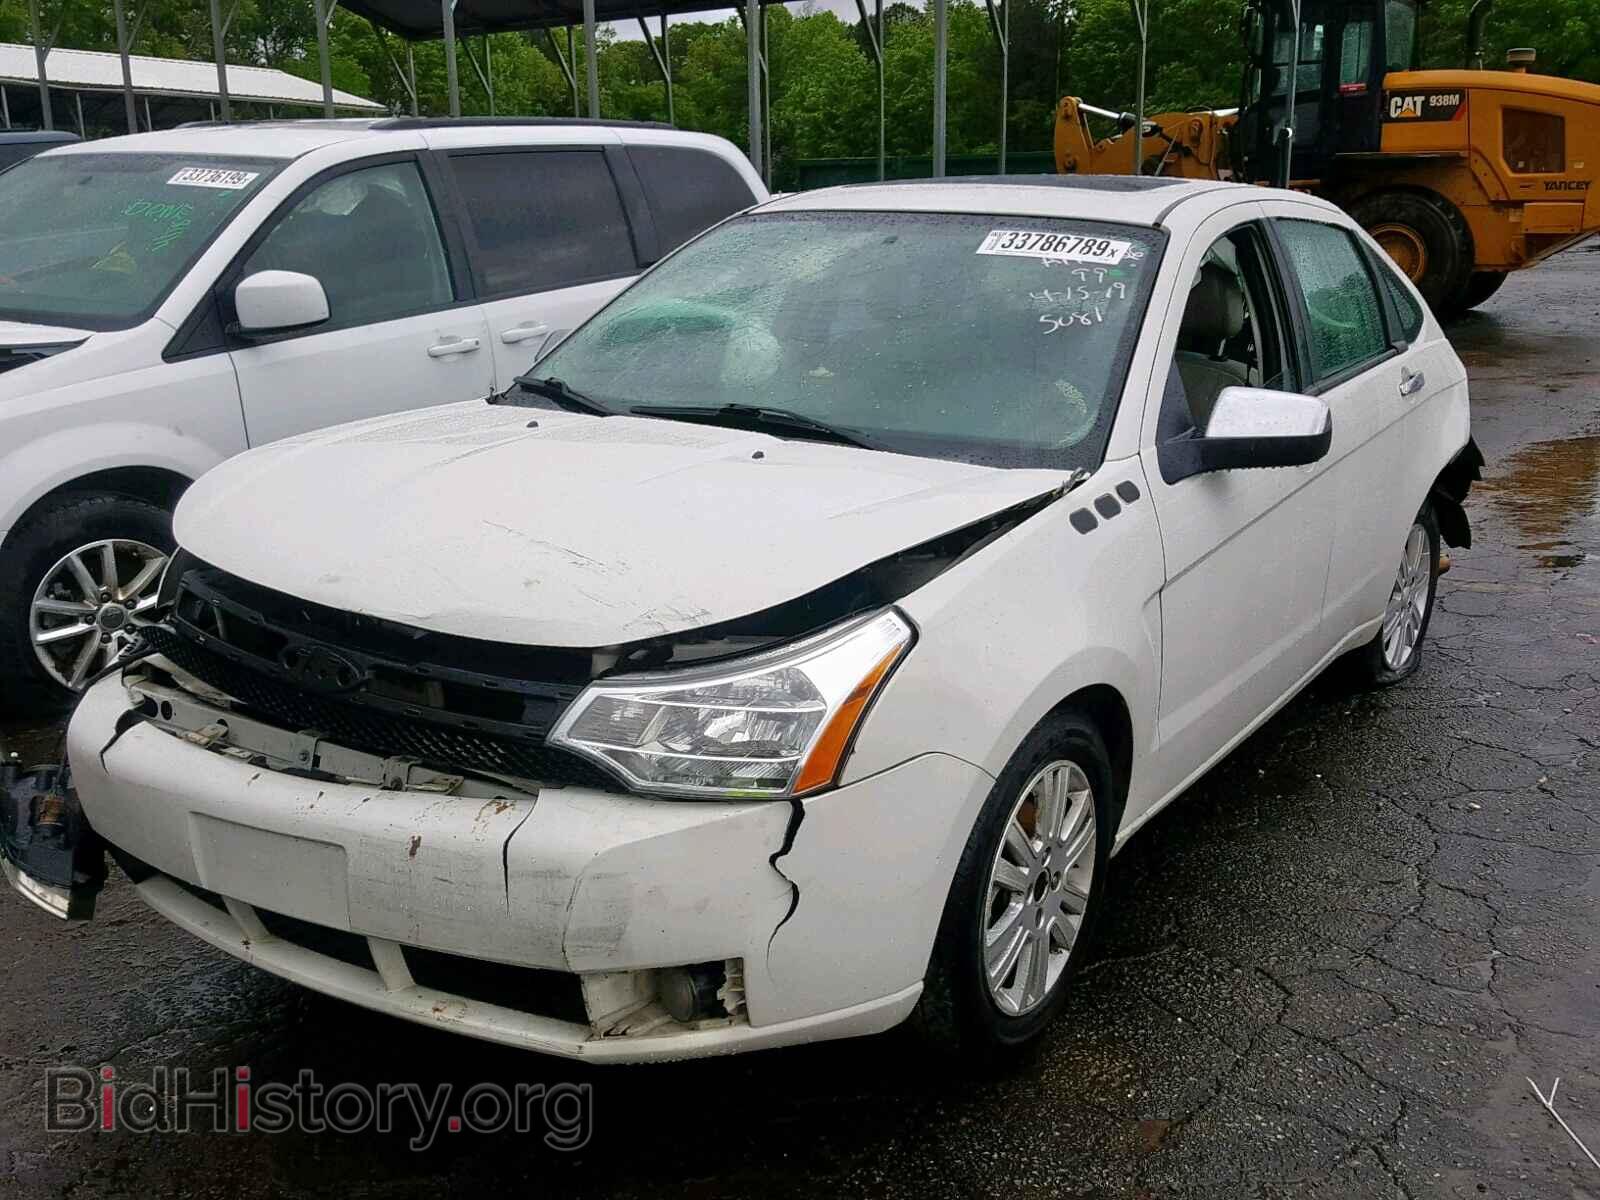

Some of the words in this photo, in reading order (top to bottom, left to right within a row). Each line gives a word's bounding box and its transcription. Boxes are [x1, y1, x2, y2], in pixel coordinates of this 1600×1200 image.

[1390, 95, 1425, 118] CAT
[1429, 94, 1460, 107] 938M
[1544, 180, 1592, 191] YANCEY
